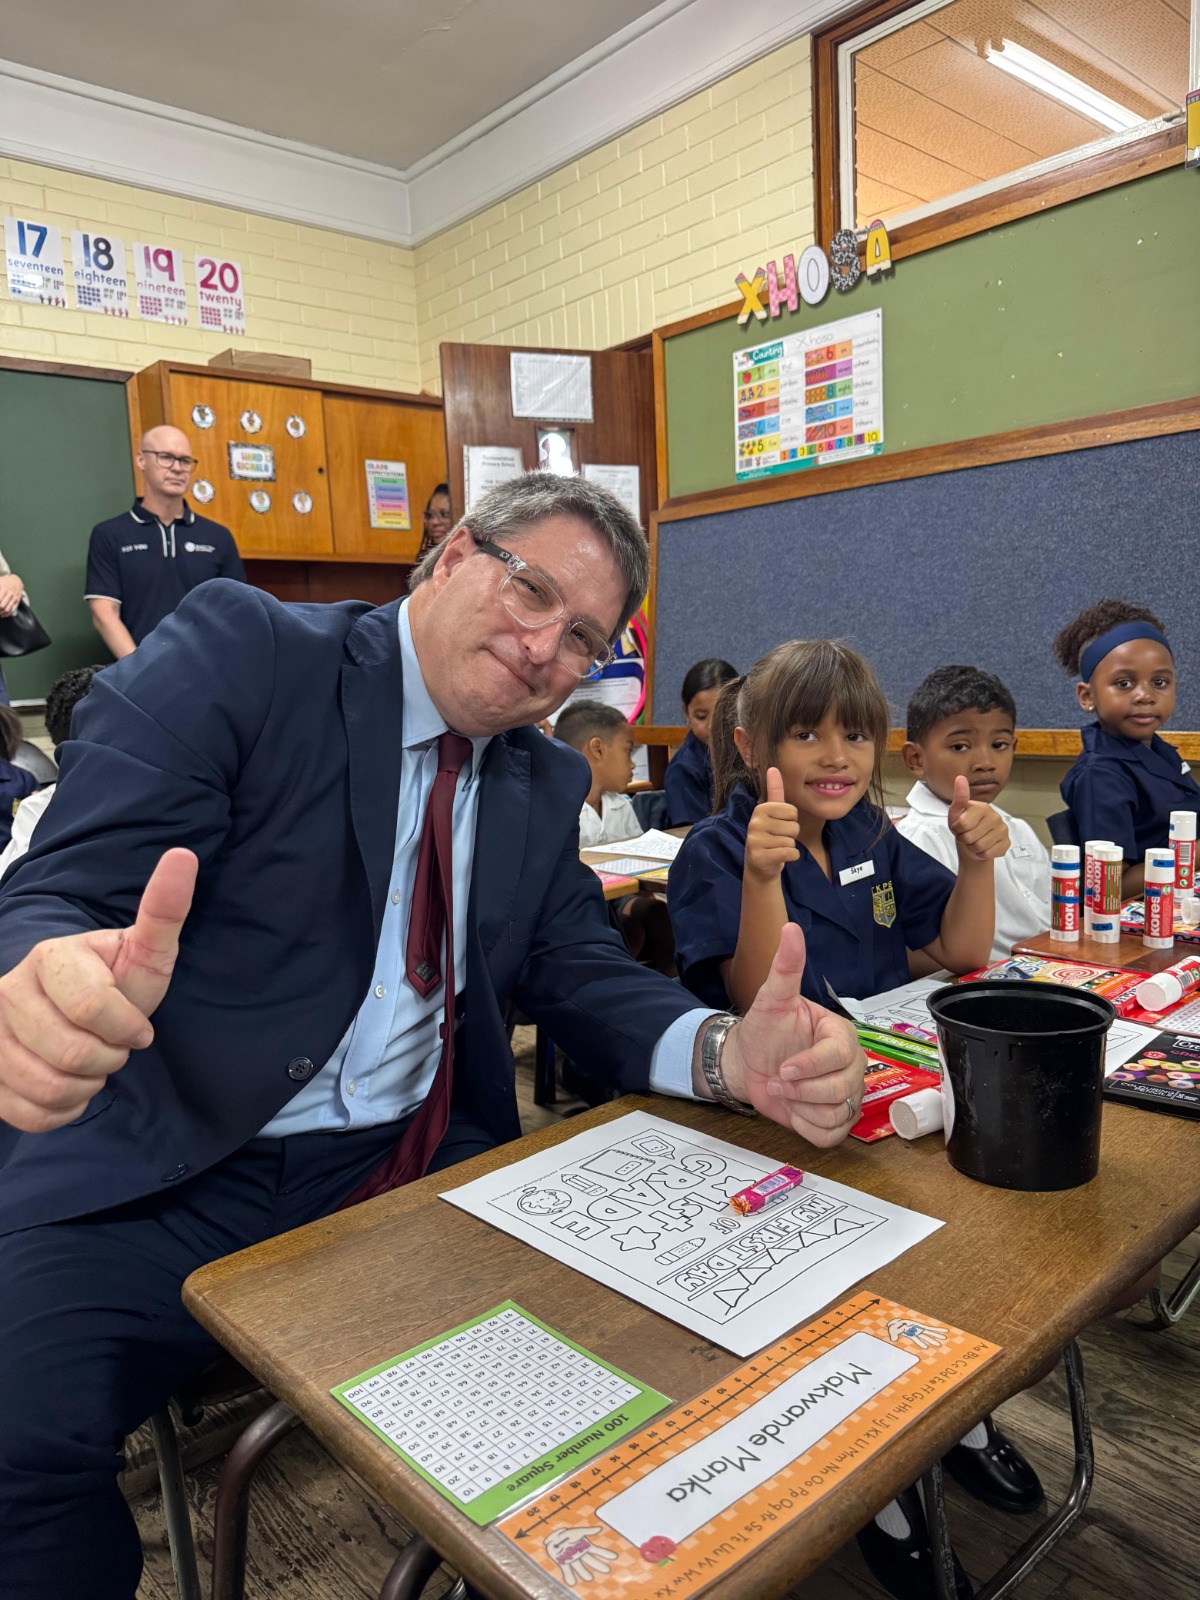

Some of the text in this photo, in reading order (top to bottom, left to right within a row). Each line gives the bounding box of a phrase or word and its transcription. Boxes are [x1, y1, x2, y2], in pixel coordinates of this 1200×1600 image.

[16, 220, 48, 258] 17
[82, 234, 115, 272] 18
[8, 258, 64, 276] seventeen
[143, 245, 176, 282] 19
[198, 258, 240, 294] 20
[735, 219, 892, 325] XHOSA
[74, 269, 127, 288] eighteen
[137, 279, 186, 297] nineteen
[199, 290, 242, 310] twenty
[752, 346, 783, 362] Counting
[826, 349, 834, 360] 6
[756, 385, 764, 398] 2
[826, 383, 835, 398] 8
[824, 424, 836, 437] 10
[756, 440, 764, 452] 5
[800, 446, 805, 456] 3
[818, 444, 824, 452] 5
[827, 440, 834, 450] 6
[837, 438, 843, 449] 7
[847, 436, 852, 446] 8
[856, 434, 862, 444] 9
[868, 432, 878, 442] 10
[850, 866, 863, 875] Skye
[1086, 854, 1095, 889] kore
[1093, 860, 1102, 902] kores
[1064, 889, 1074, 930] kors
[1150, 896, 1160, 937] kores
[550, 1153, 727, 1241] GRADE
[709, 1217, 741, 1235] OF
[674, 1196, 836, 1292] MY FIRST DAY
[976, 1342, 989, 1352] Aa
[954, 1360, 967, 1368] Cc
[563, 1370, 575, 1378] 32
[941, 1368, 957, 1378] Dd
[577, 1379, 589, 1387] 22
[530, 1389, 542, 1397] 34
[560, 1389, 572, 1397] 23
[925, 1384, 935, 1394] Ff
[544, 1398, 556, 1406] 24
[700, 1398, 710, 1406] 11
[902, 1392, 925, 1402] Gg
[513, 1399, 525, 1407] 35
[893, 1403, 912, 1413] Hh
[527, 1409, 539, 1417] 25
[591, 1408, 600, 1416] 3
[682, 1409, 694, 1417] 12
[886, 1412, 899, 1421] Ii
[478, 1419, 489, 1428] 37
[509, 1419, 521, 1427] 26
[664, 1420, 676, 1428] 13
[872, 1418, 890, 1429] Jj
[458, 1430, 471, 1438] 38
[492, 1429, 503, 1438] 27
[646, 1430, 658, 1438] 14
[665, 1362, 873, 1503] Makwande Manka
[863, 1427, 882, 1440] Kk
[440, 1441, 452, 1450] 39
[472, 1440, 485, 1449] 28
[506, 1441, 516, 1449] 17
[628, 1442, 640, 1450] 15
[854, 1434, 870, 1448] Ll
[420, 1453, 432, 1462] 40
[454, 1452, 465, 1461] 29
[486, 1452, 498, 1460] 18
[506, 1414, 629, 1492] 100 Number Square
[835, 1447, 859, 1462] Mm
[609, 1454, 620, 1463] 16
[433, 1464, 446, 1473] 30
[468, 1463, 479, 1471] 19
[502, 1463, 511, 1471] 8
[591, 1467, 602, 1476] 17
[820, 1462, 840, 1474] Nn
[447, 1474, 460, 1485] 20
[570, 1480, 582, 1489] 18
[805, 1475, 824, 1486] Oo
[462, 1487, 474, 1496] 10
[789, 1486, 809, 1498] Pp
[549, 1494, 560, 1502] 19
[768, 1498, 793, 1510] Qq
[526, 1506, 540, 1518] 20
[760, 1510, 777, 1522] Rr
[744, 1521, 762, 1531] Ss
[731, 1532, 748, 1542] Tt
[713, 1543, 735, 1556] Uu
[698, 1557, 718, 1568] Vv
[673, 1568, 702, 1586] Ww
[654, 1584, 676, 1598] Xx
